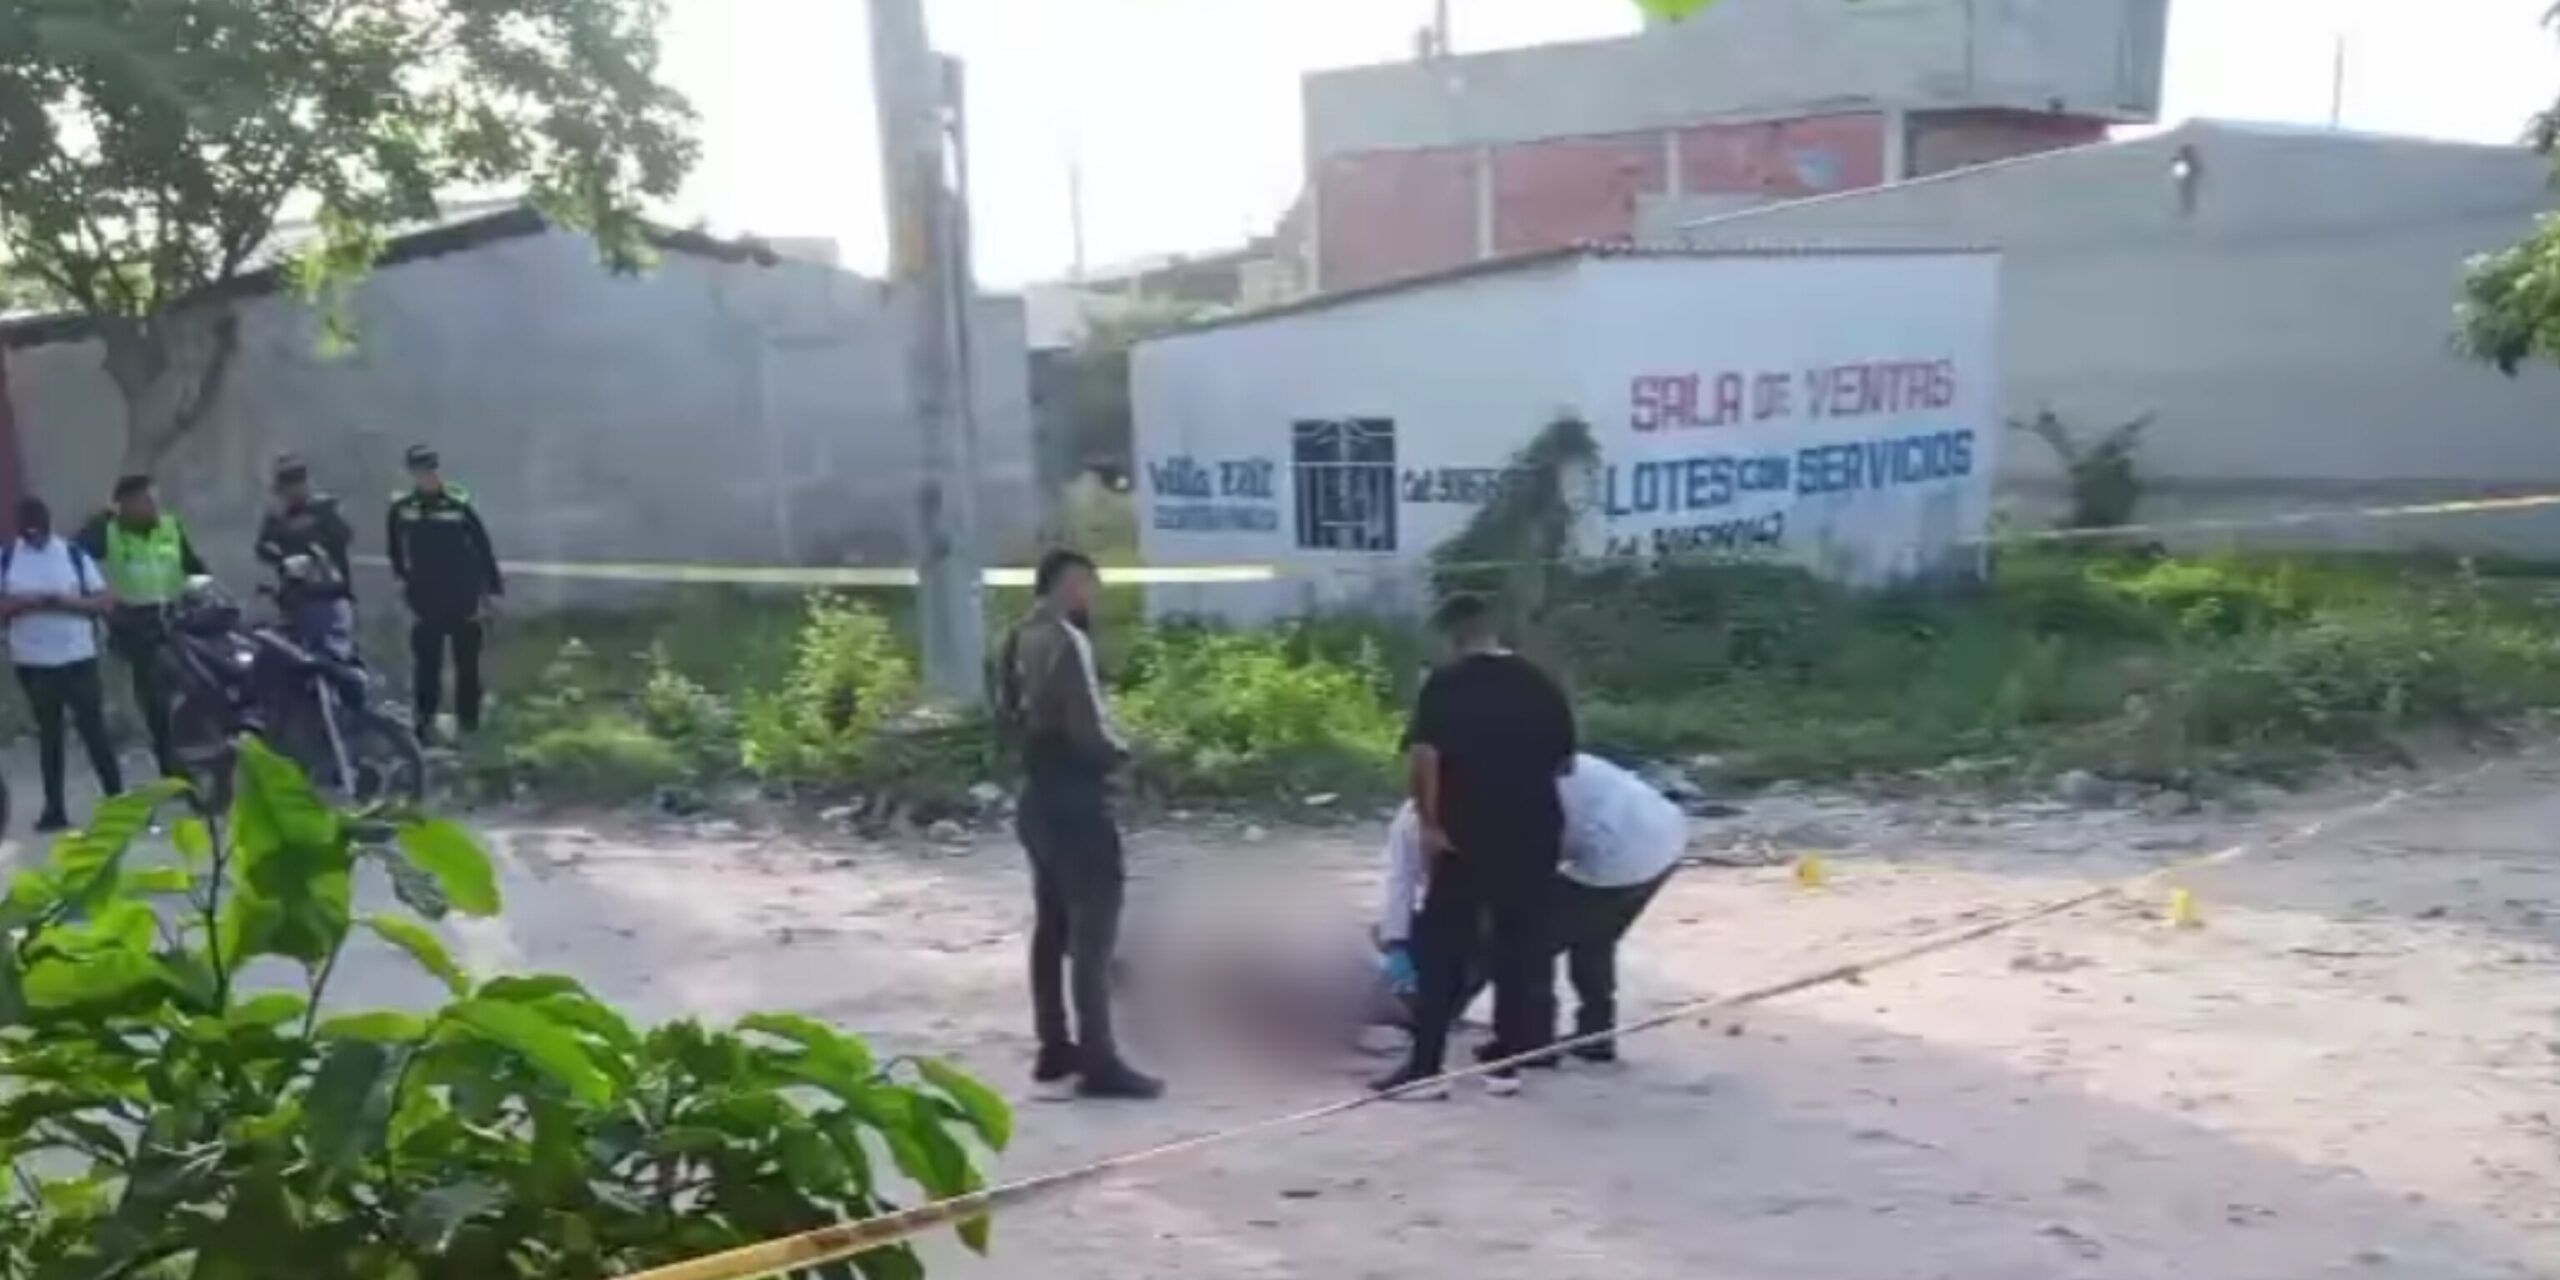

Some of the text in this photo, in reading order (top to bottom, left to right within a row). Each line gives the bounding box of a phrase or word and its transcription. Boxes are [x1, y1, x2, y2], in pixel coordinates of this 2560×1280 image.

[1631, 357, 1955, 432] SALA DE VENTAS
[1602, 455, 1736, 518] LOTES
[1796, 429, 1975, 497] SERVICIOS
